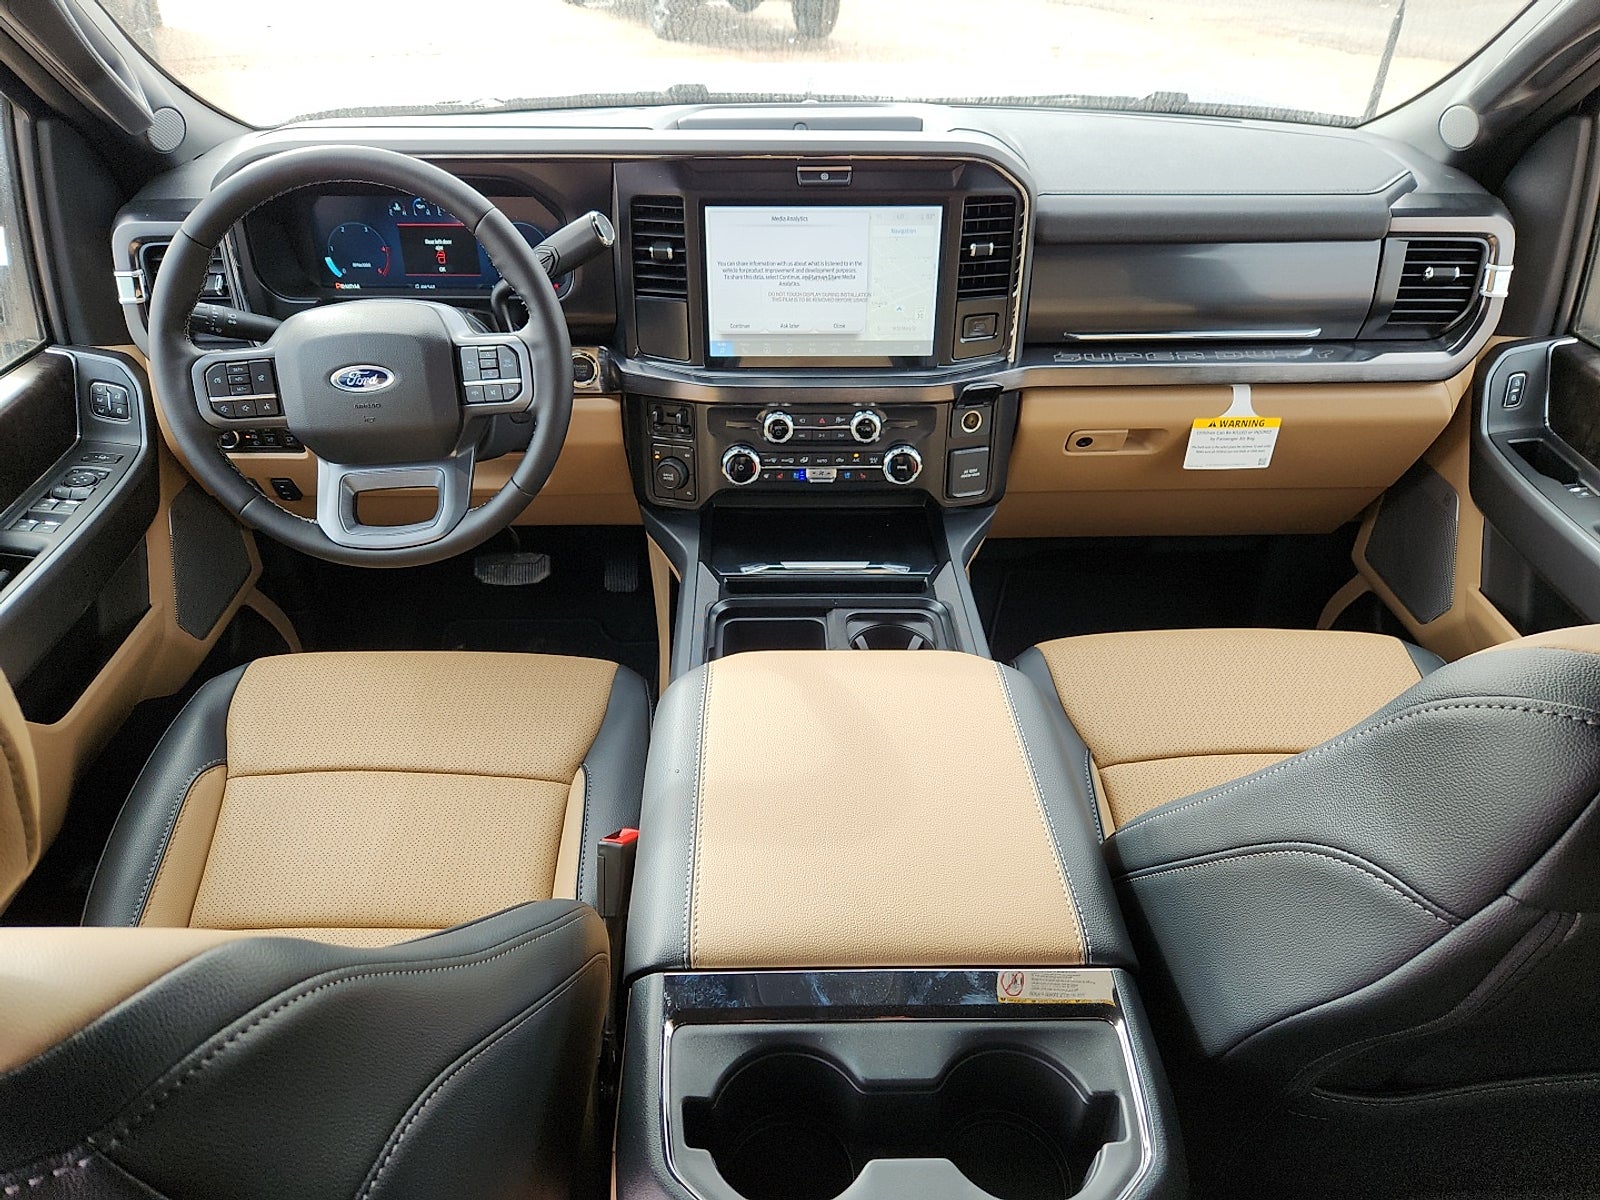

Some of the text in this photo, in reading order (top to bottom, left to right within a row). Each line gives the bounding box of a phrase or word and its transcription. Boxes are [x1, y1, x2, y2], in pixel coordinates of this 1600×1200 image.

[1053, 352, 1206, 362] SUPER
[347, 371, 378, 385] Ford
[1219, 419, 1266, 428] WARNING
